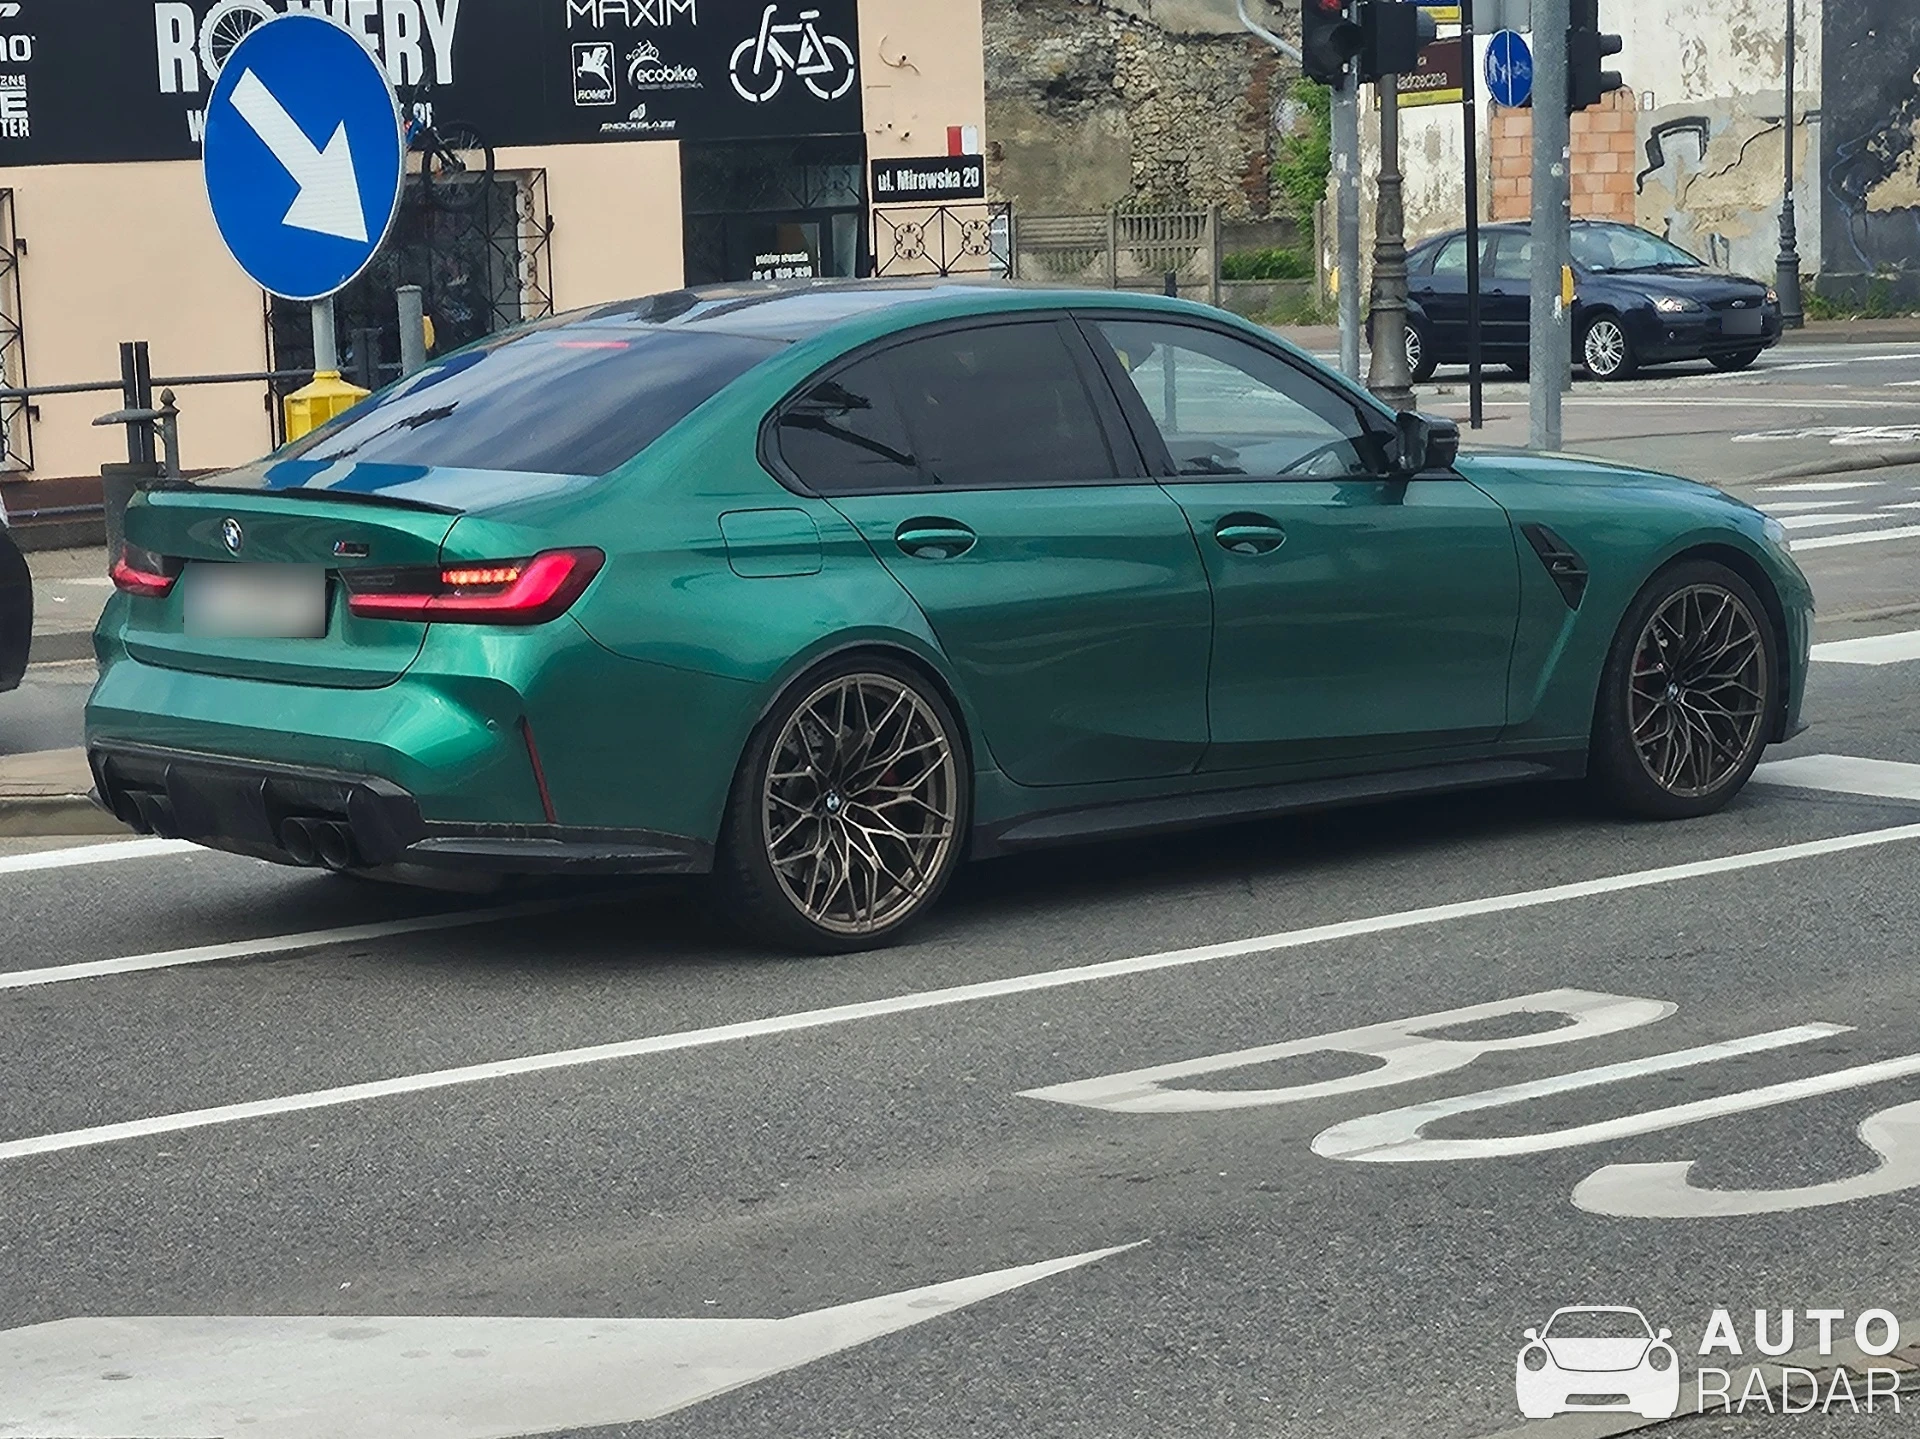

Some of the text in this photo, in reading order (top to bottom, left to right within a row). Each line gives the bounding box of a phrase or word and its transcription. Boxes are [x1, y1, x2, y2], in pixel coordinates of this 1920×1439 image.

[566, 0, 697, 29] MAXIM
[636, 64, 698, 83] ecobike
[878, 166, 980, 191] ul. Mirowska 20
